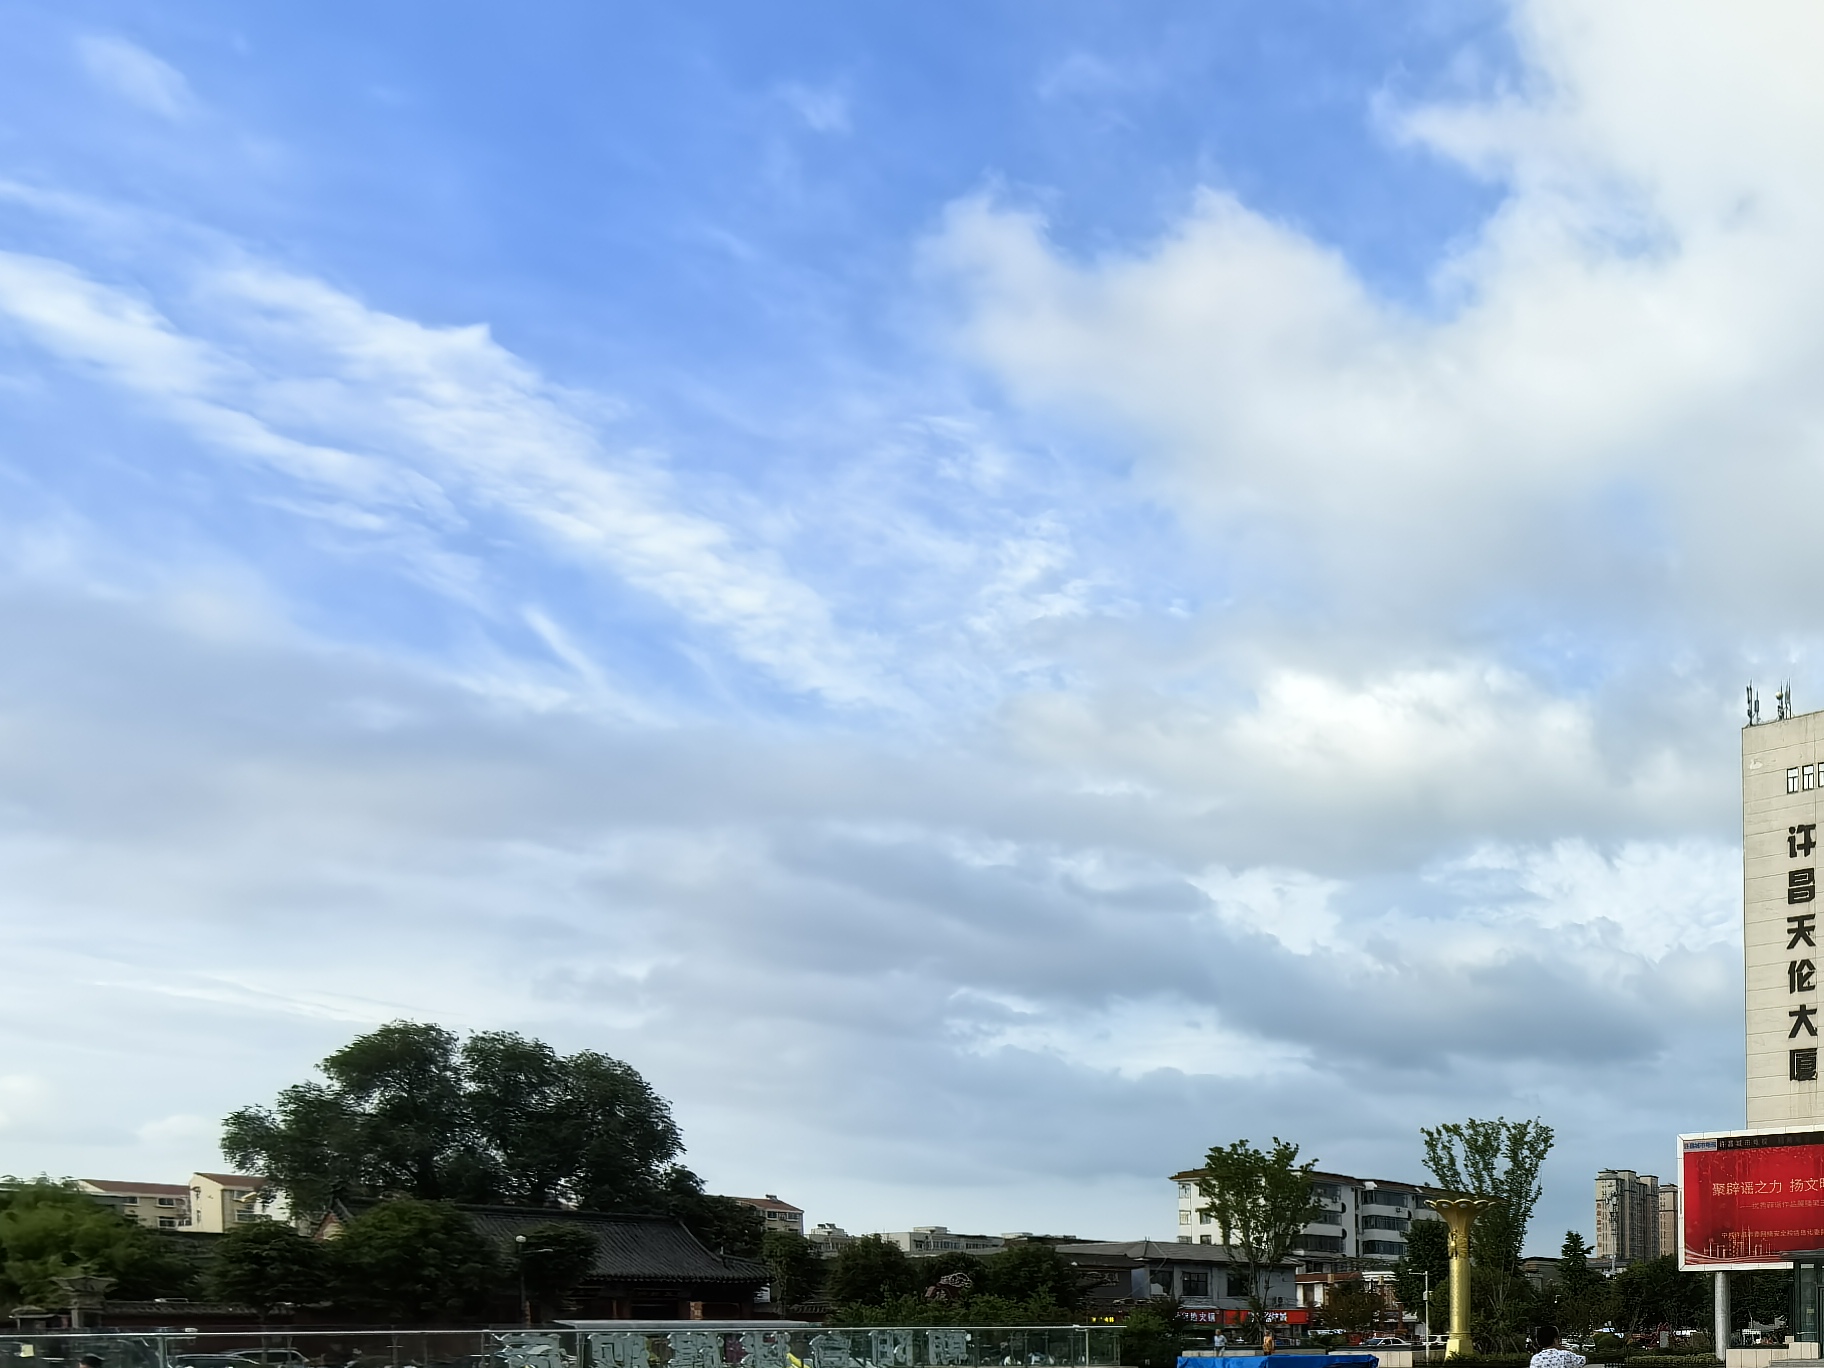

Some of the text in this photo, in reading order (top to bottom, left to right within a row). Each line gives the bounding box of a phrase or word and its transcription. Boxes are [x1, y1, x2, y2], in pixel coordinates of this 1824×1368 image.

[1787, 824, 1818, 1082] 许昌天伦大厦
[1712, 1180, 1782, 1196] 聚辟谣之力
